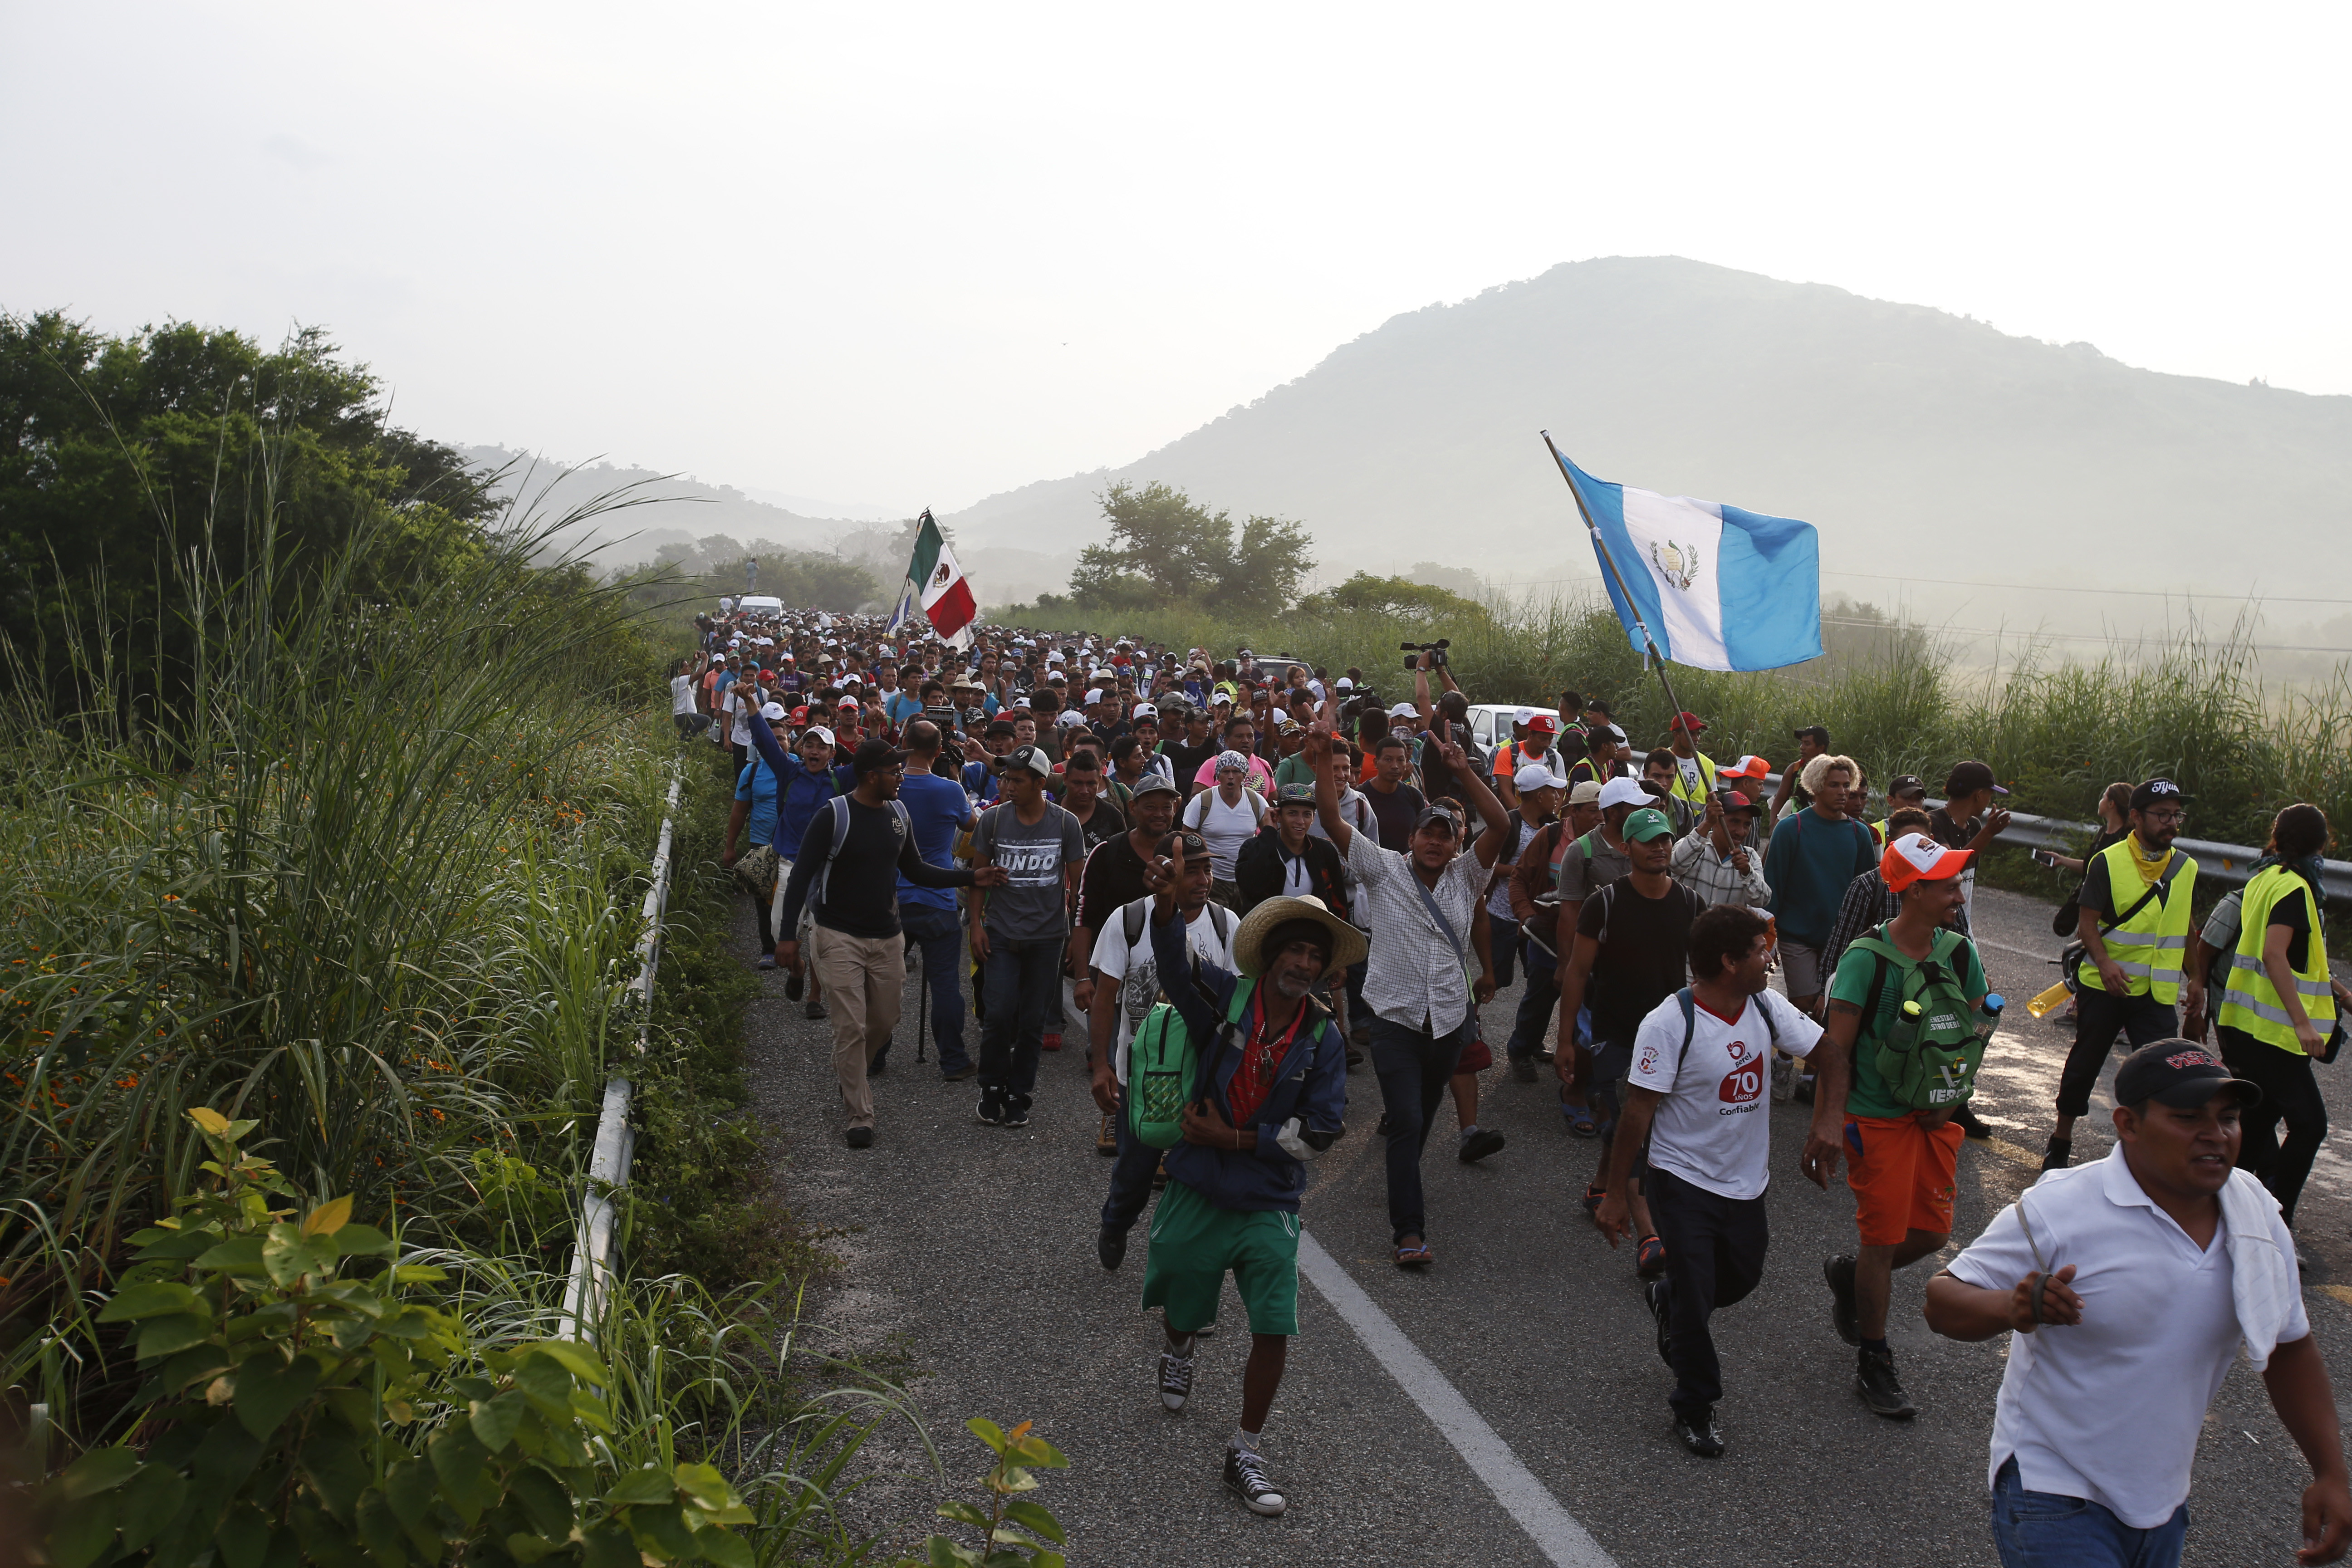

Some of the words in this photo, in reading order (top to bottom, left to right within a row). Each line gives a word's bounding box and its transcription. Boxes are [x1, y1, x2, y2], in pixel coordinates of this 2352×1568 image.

[1688, 772, 1696, 784] R
[1000, 853, 1056, 870] UNDO
[1930, 1014, 1955, 1023] ENESTAR
[1931, 1023, 1946, 1031] STRO
[1735, 1052, 1752, 1068] Berel
[1730, 1071, 1759, 1096] 70
